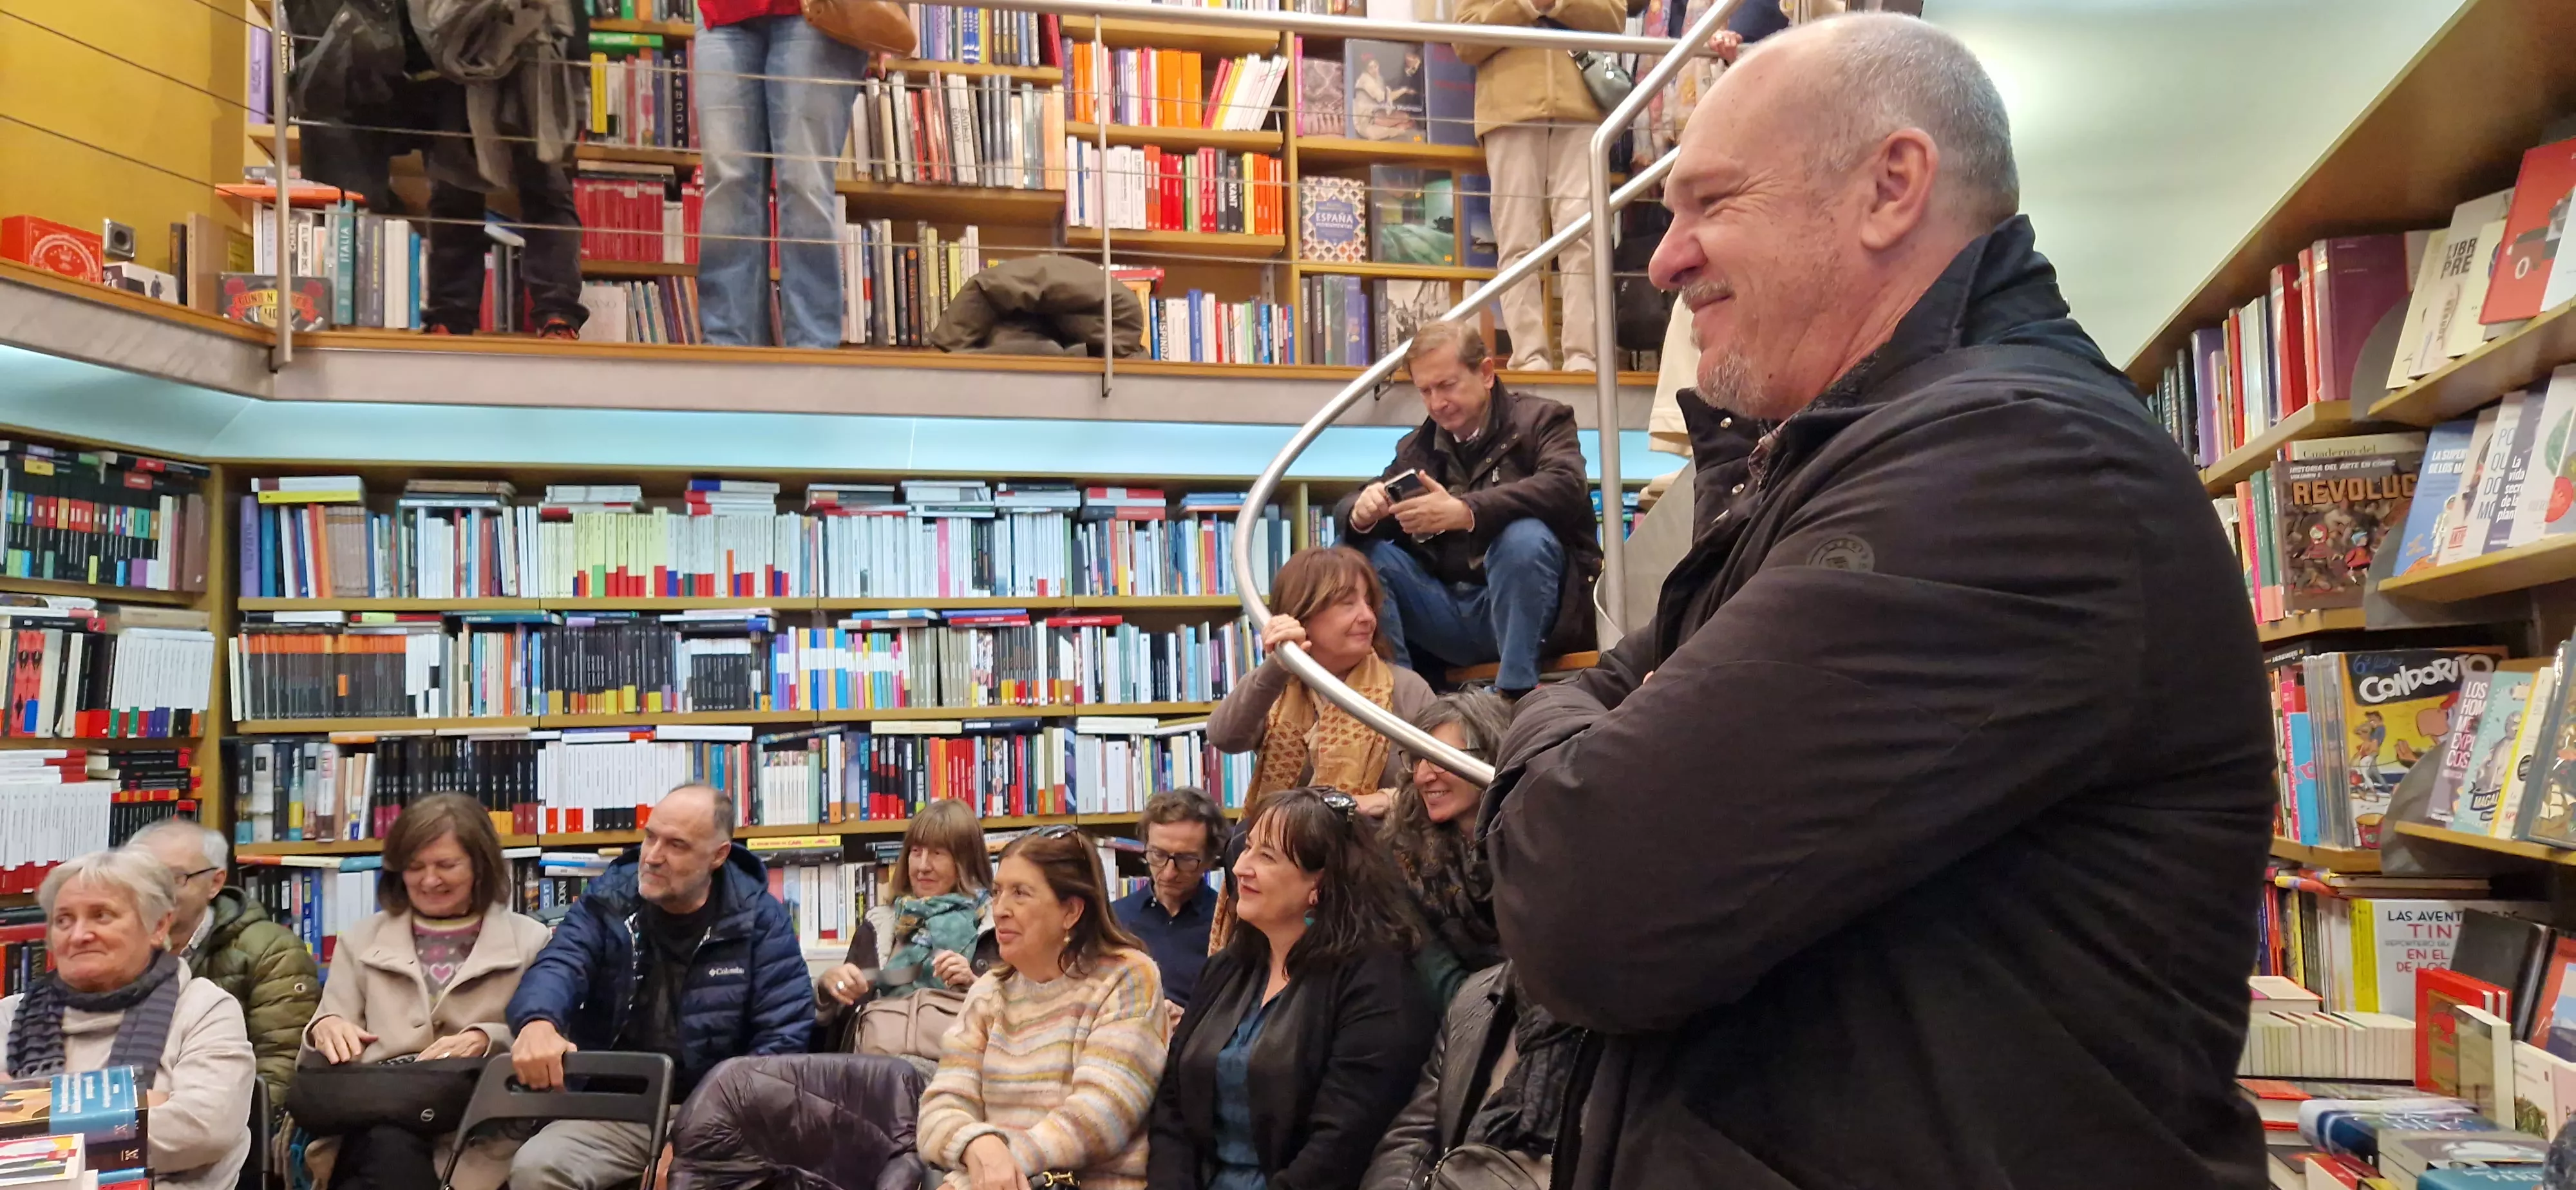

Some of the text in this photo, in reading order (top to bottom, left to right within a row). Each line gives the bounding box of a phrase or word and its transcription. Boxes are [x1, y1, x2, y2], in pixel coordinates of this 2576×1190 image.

[1227, 182, 1238, 207] KANT
[1316, 212, 1353, 223] ESPAÑA
[340, 227, 350, 263] ITALIA
[1159, 324, 1169, 362] SPINOZ
[2290, 464, 2323, 474] HISTORIA
[2324, 462, 2338, 471] DEL
[2339, 461, 2359, 470] ARTE
[2512, 455, 2522, 469] La
[2508, 469, 2526, 482] vida
[2500, 495, 2510, 507] de
[2359, 654, 2494, 703] CONDORITO
[2465, 681, 2488, 699] LOS
[2388, 911, 2463, 921] LAS AVENT
[2407, 949, 2450, 959] EN EL
[715, 967, 745, 975] Columbia
[2396, 961, 2412, 972] DE
